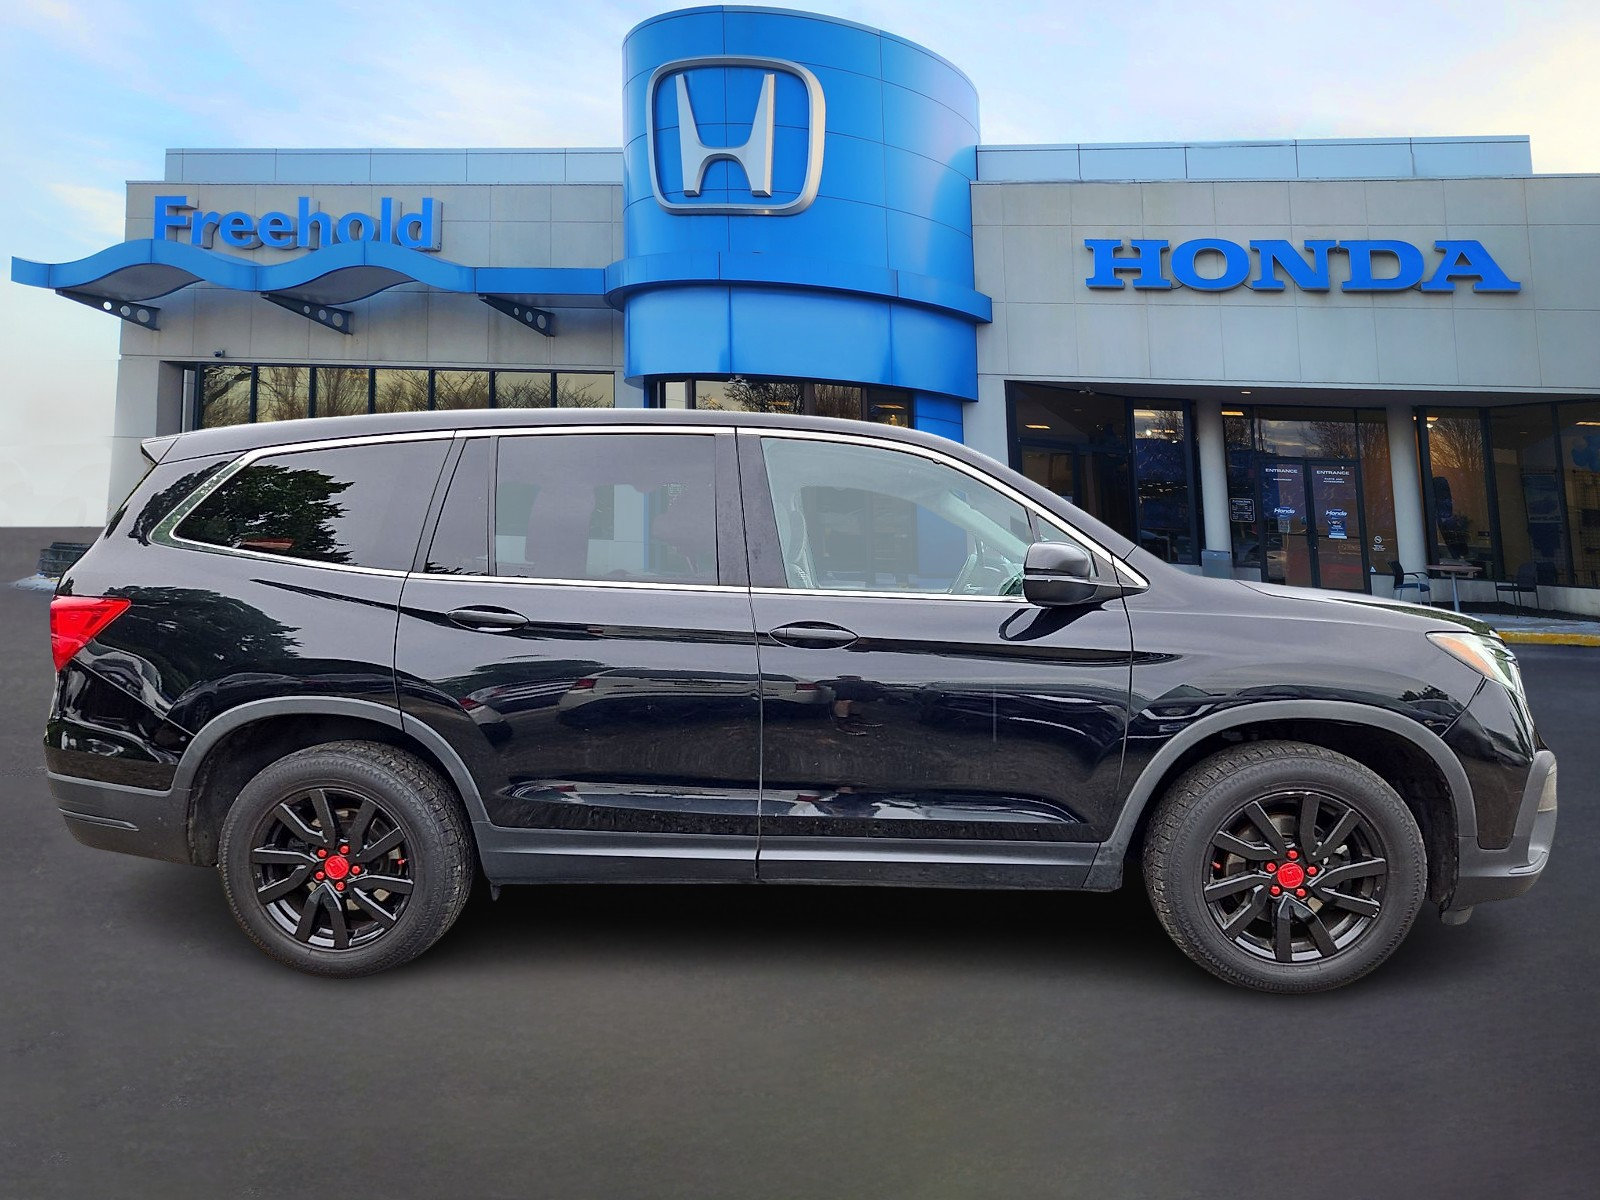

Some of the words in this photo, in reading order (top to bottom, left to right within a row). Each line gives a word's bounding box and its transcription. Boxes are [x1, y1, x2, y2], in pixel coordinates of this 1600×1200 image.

[153, 195, 435, 249] Freehold
[1084, 238, 1521, 293] HONDA
[1273, 507, 1296, 515] Honda
[1325, 509, 1348, 517] Honda
